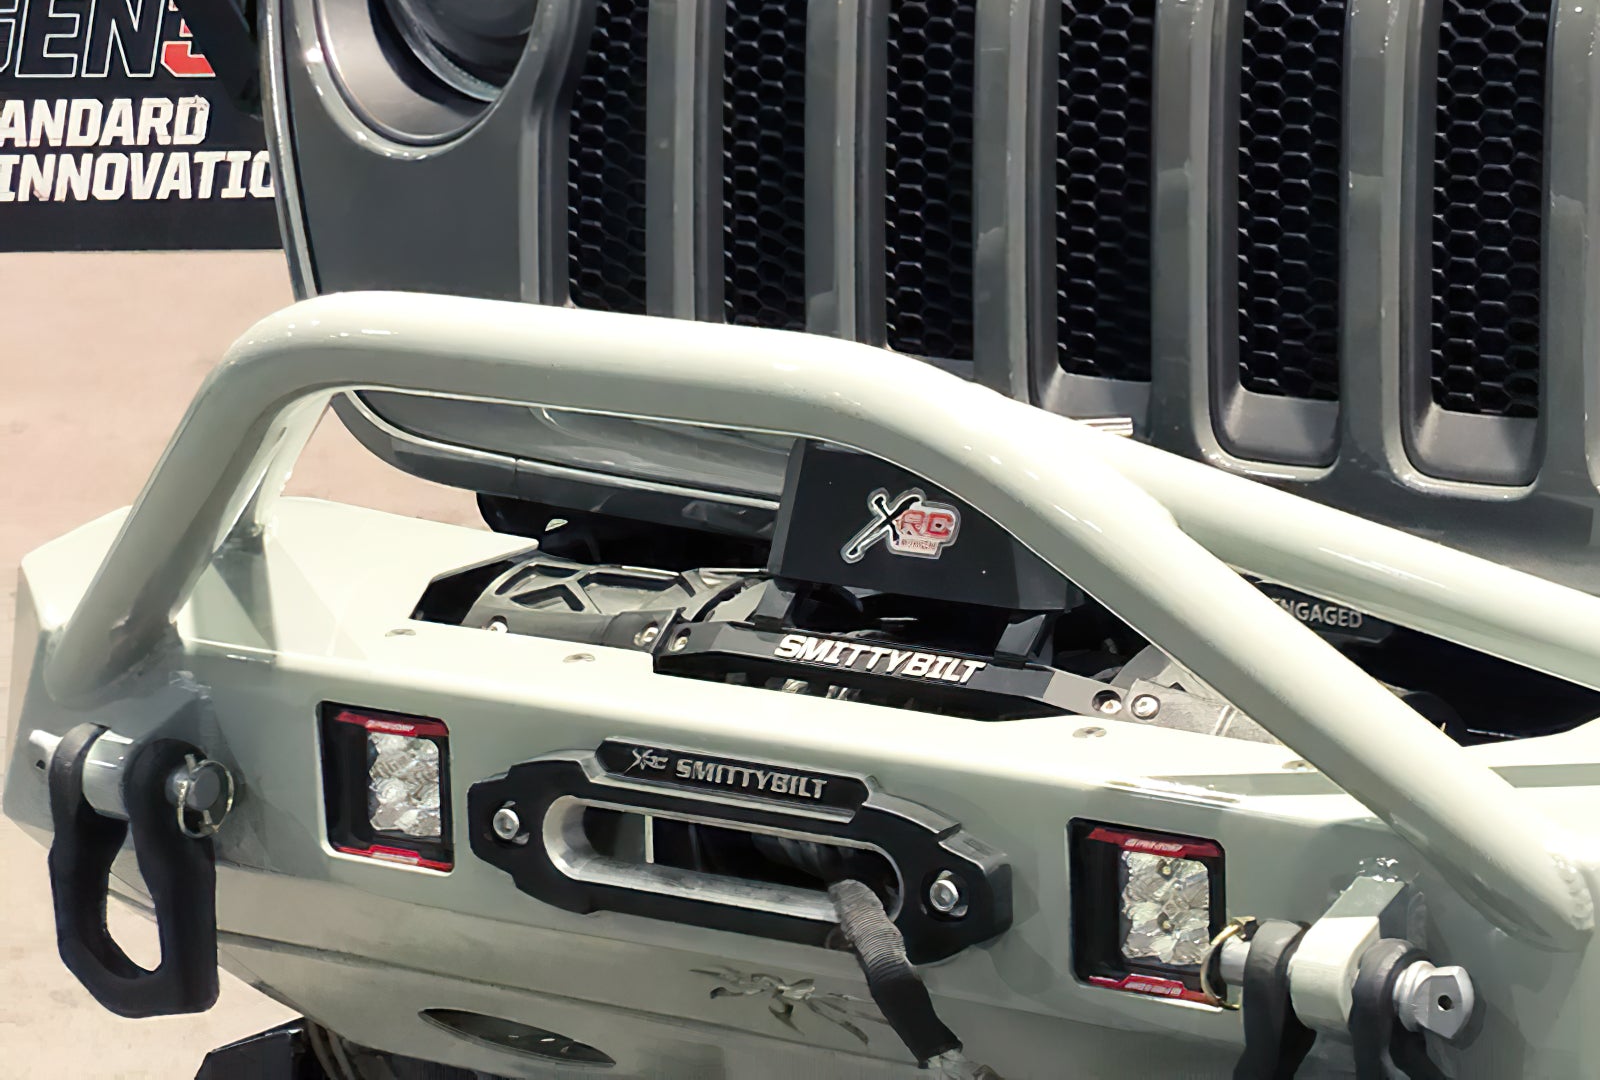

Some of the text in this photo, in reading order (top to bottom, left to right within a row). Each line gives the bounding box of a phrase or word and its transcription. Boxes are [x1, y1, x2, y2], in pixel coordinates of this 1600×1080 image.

[0, 96, 210, 148] ANDARD
[1272, 597, 1362, 628] NGAGED
[774, 633, 987, 684] SMITTYBILT
[675, 758, 828, 799] SMITTYBILT
